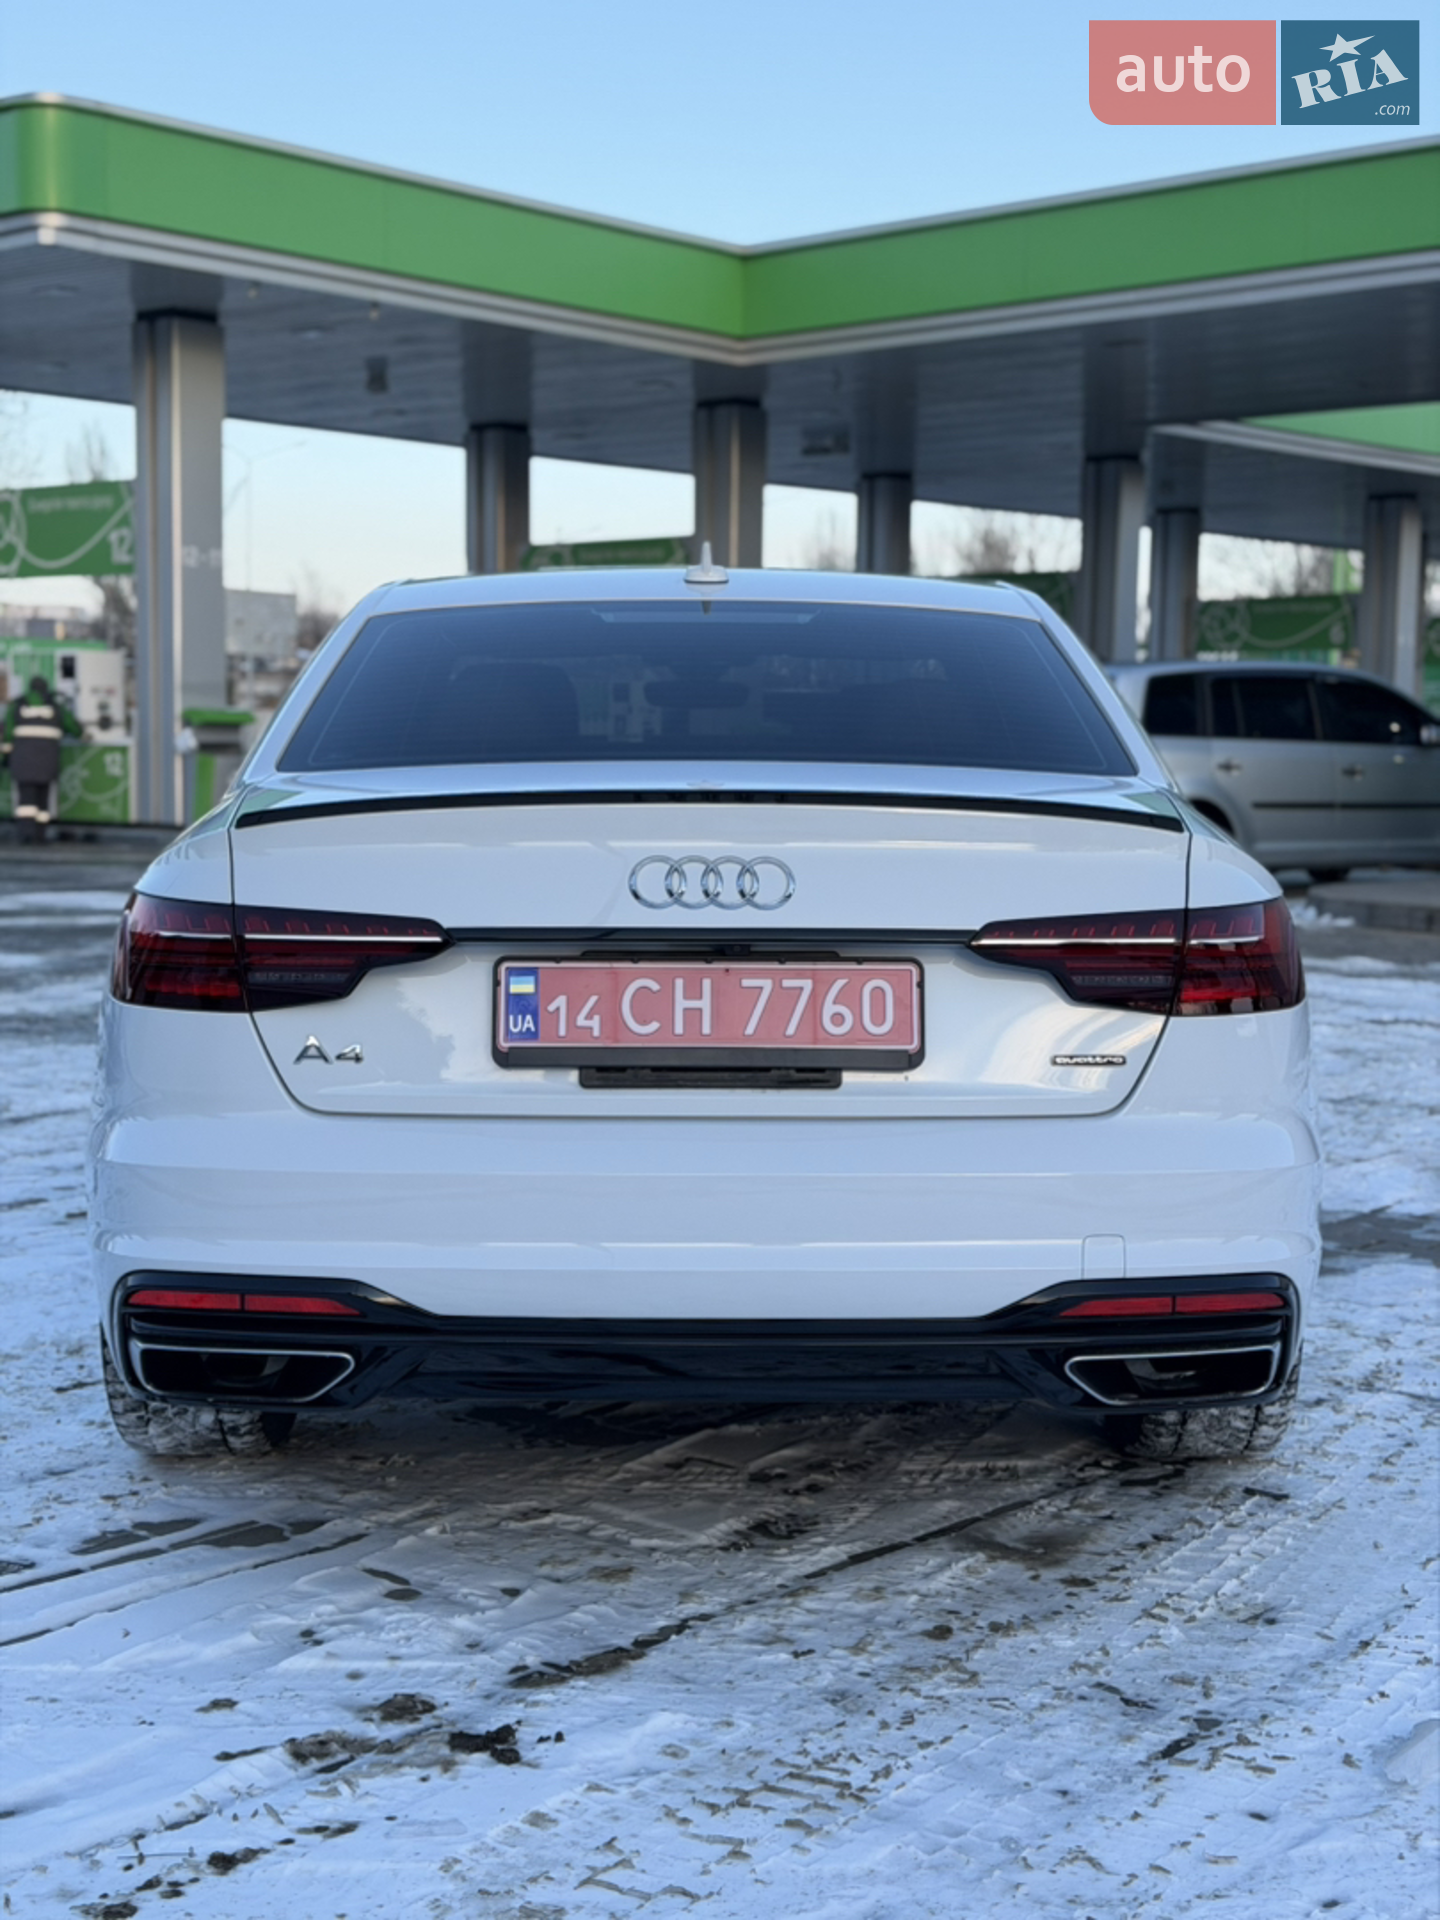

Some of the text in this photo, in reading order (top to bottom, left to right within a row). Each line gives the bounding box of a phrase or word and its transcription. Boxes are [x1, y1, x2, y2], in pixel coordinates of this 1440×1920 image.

[546, 978, 895, 1038] 14 CH 7760
[509, 1014, 535, 1033] UA
[293, 1035, 363, 1065] A4
